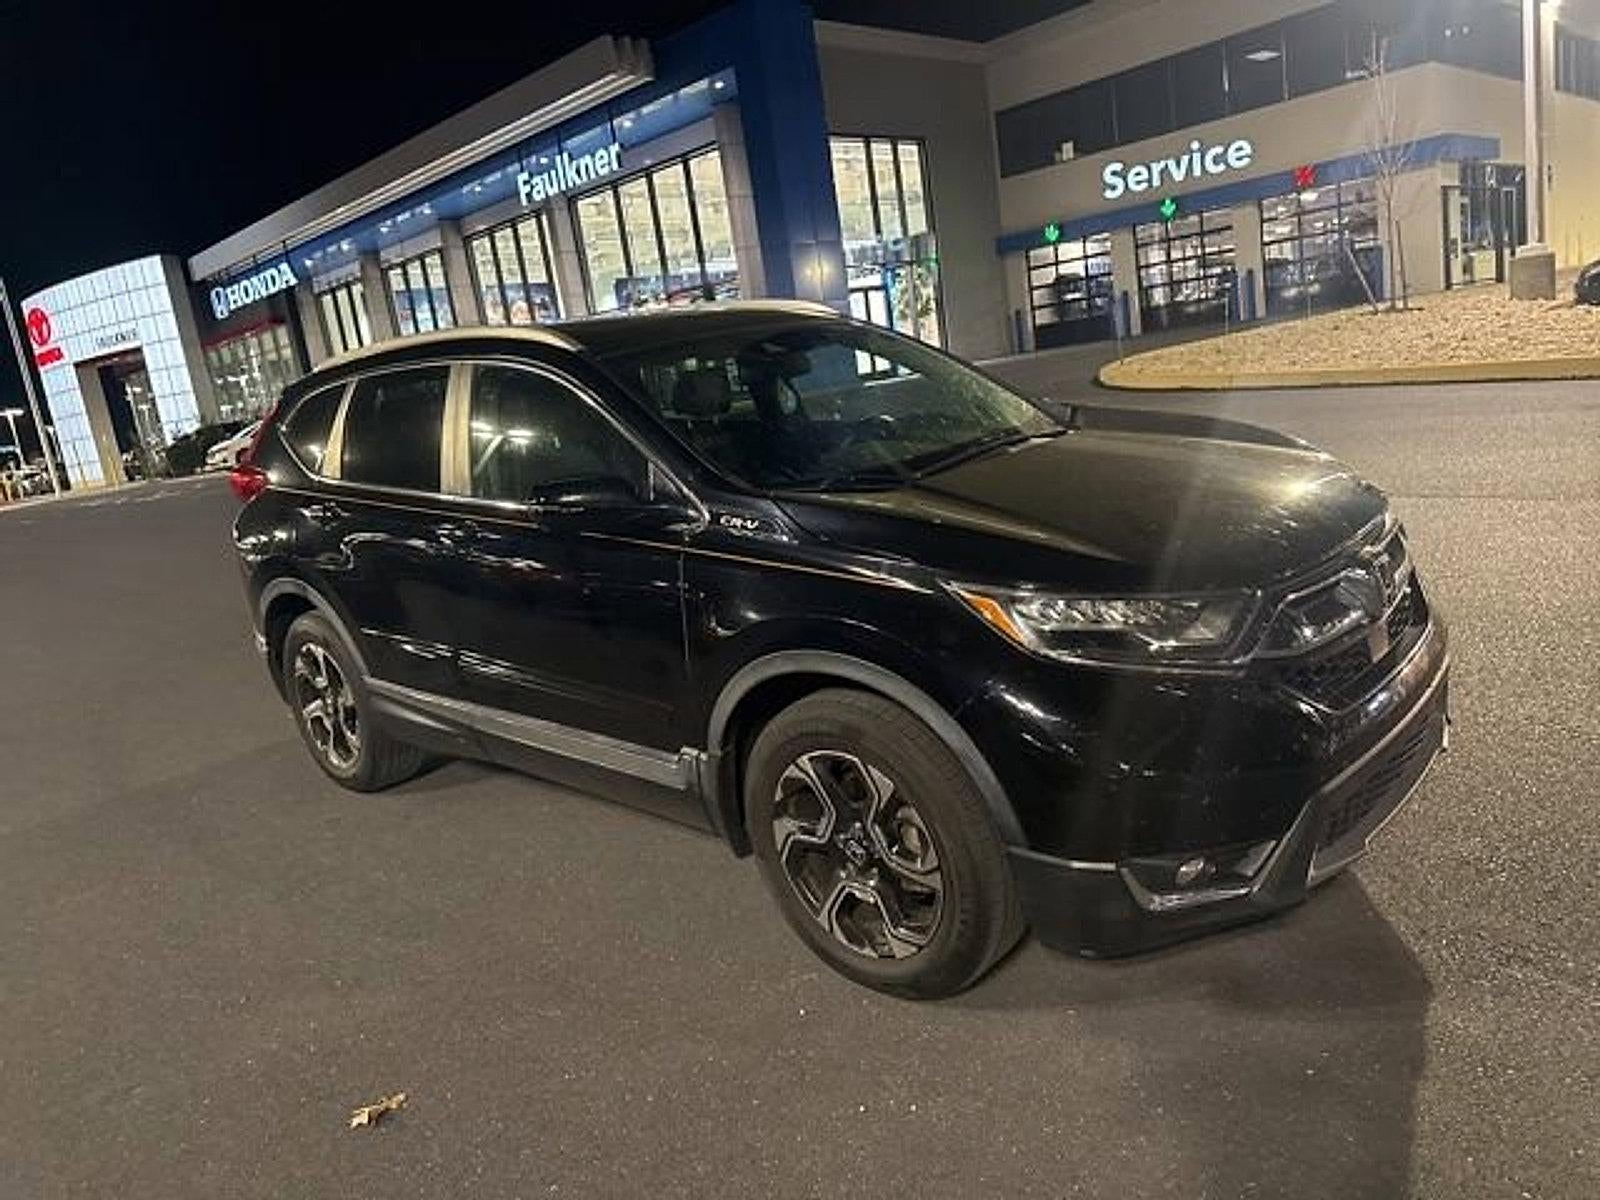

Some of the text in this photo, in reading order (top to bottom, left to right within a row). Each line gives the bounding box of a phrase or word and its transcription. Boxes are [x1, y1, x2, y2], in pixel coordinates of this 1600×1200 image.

[517, 142, 619, 206] Faulkner
[1102, 140, 1252, 199] Service
[226, 262, 298, 310] HONDA
